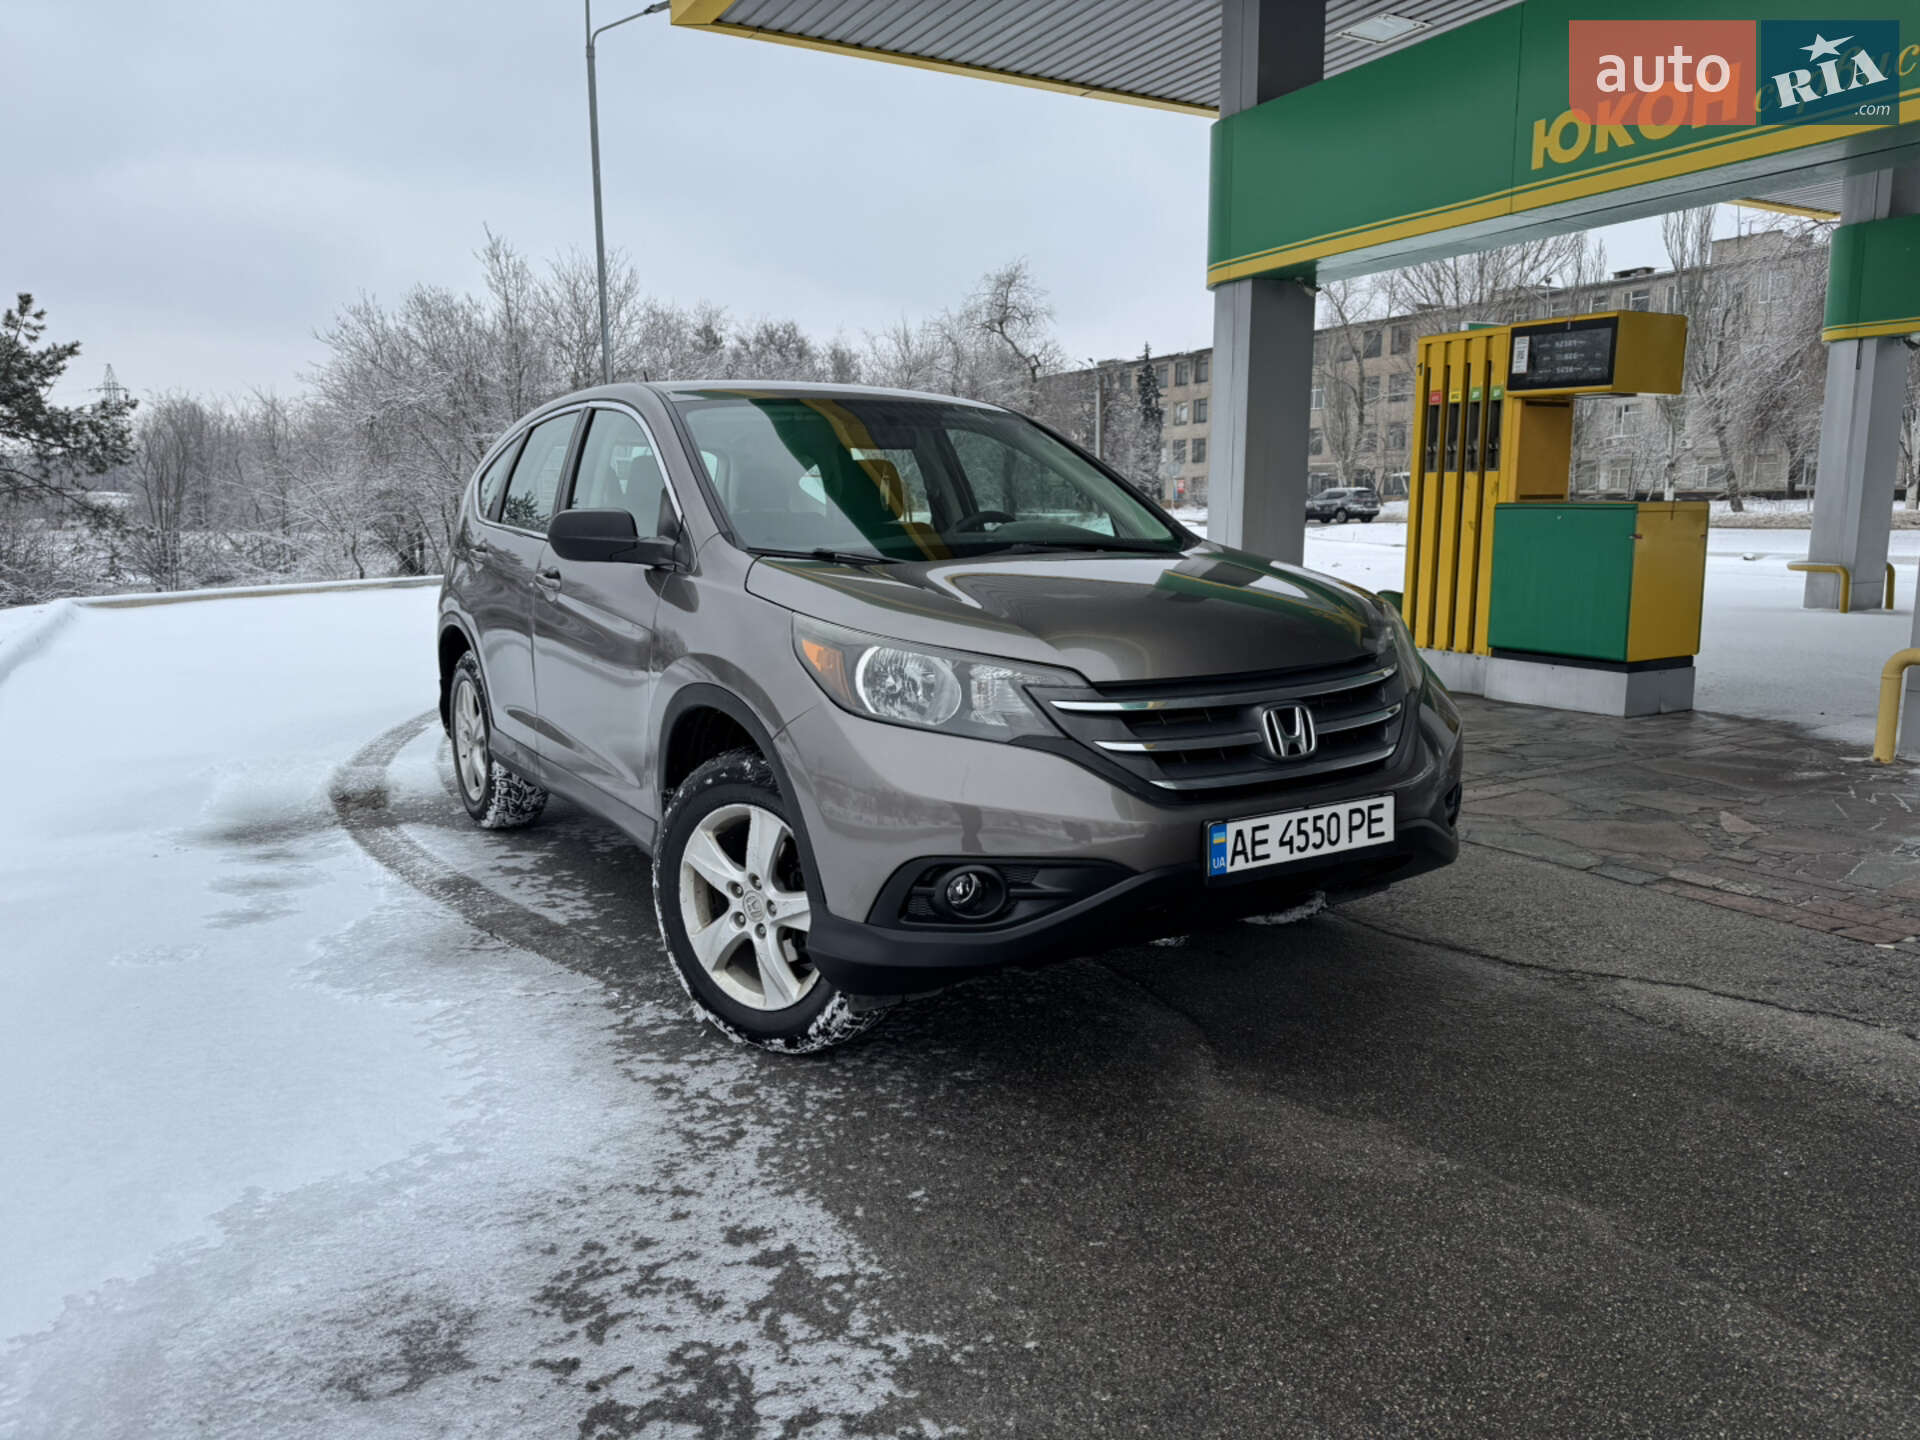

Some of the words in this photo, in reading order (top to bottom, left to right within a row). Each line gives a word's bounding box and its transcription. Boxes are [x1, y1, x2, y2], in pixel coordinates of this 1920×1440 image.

[1530, 62, 1742, 171] ЮКОН
[1212, 856, 1226, 870] UA
[1229, 824, 1271, 867] AE
[1278, 812, 1341, 855] 4550
[1348, 803, 1385, 844] PE
